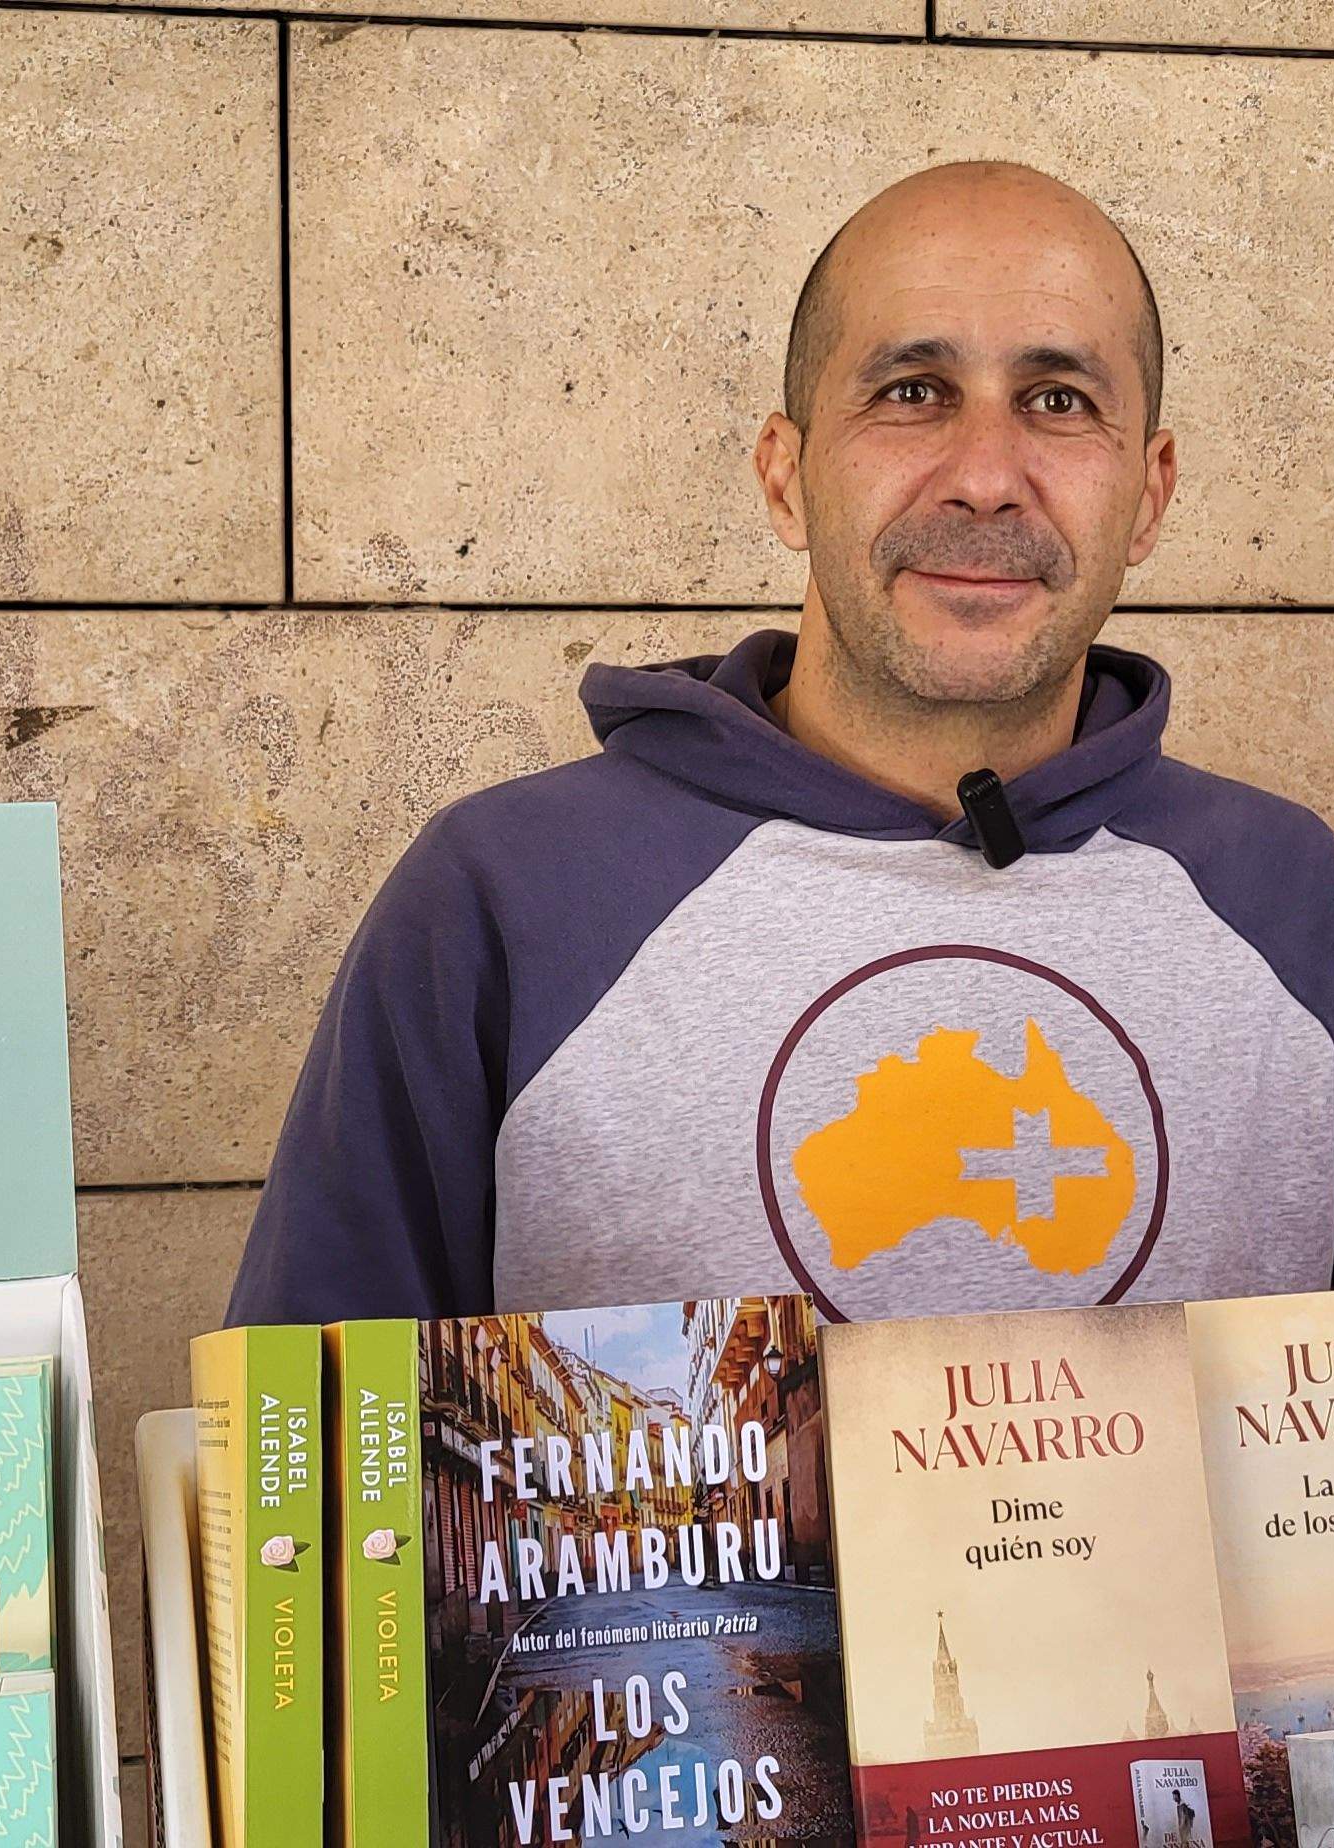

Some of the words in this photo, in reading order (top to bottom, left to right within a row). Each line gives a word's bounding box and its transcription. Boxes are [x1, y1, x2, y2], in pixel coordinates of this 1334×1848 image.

[943, 1357, 1087, 1421] JULIA
[260, 1394, 281, 1510] ALLENDE
[288, 1407, 309, 1495] ISABEL
[360, 1388, 381, 1503] ALLENDE
[386, 1401, 407, 1489] ISABEL
[480, 1420, 768, 1502] FERNANDO
[891, 1411, 1145, 1474] NAVARRO
[992, 1496, 1064, 1525] Dime
[1303, 1474, 1334, 1500] La
[966, 1535, 1044, 1571] quién
[1052, 1534, 1097, 1560] soy
[1265, 1512, 1298, 1539] de
[479, 1517, 782, 1604] ARAMBURU
[274, 1597, 294, 1711] VIOLETA
[377, 1590, 398, 1704] VIOLETA
[512, 1631, 551, 1653] Autor
[555, 1627, 577, 1649] del
[580, 1623, 648, 1646] fenómeno
[652, 1618, 710, 1642] literario
[715, 1613, 758, 1636] Patria
[593, 1671, 689, 1743] LOS
[509, 1755, 784, 1846] VENCEJOS
[929, 1815, 952, 1834] LA
[958, 1809, 1033, 1832] NOVELA
[1039, 1800, 1080, 1822] MÁS
[931, 1791, 959, 1808] NO
[963, 1785, 989, 1805] TE
[993, 1779, 1073, 1802] PIERDAS
[1011, 1835, 1023, 1848] Y
[1030, 1828, 1104, 1847] ACTUAL
